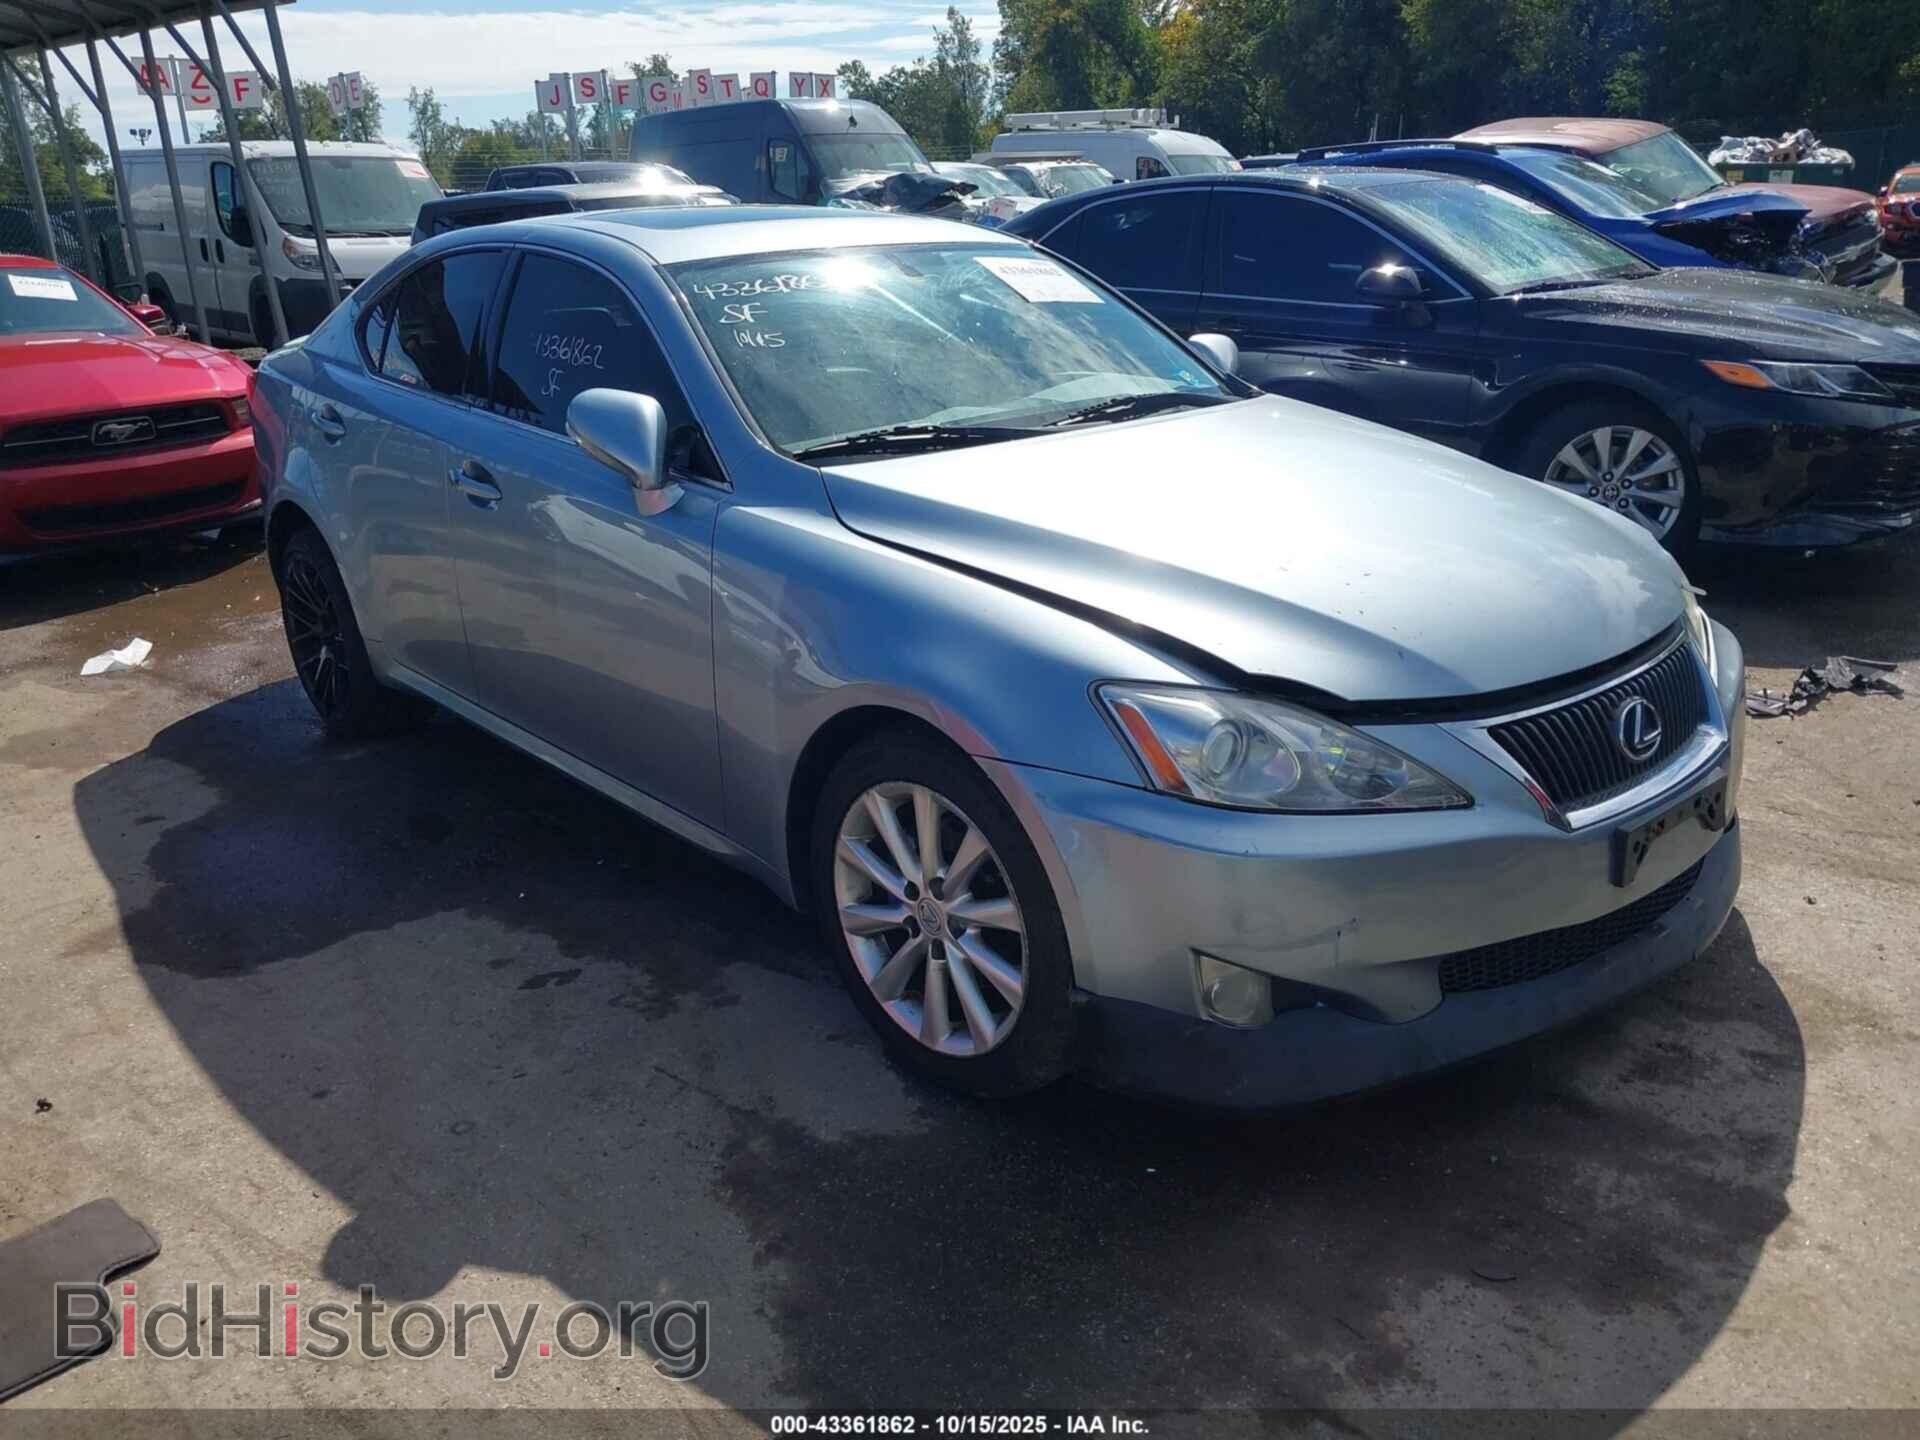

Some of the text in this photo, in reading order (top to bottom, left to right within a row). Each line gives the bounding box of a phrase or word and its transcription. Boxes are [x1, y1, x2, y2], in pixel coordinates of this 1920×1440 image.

[189, 64, 210, 90] Z
[580, 77, 596, 98] S
[697, 75, 708, 95] S
[793, 78, 806, 97] Y
[233, 78, 250, 102] F
[350, 79, 360, 101] E
[549, 84, 561, 106] J
[617, 84, 629, 105] F
[650, 82, 667, 102] G
[720, 79, 733, 98] T
[754, 78, 769, 98] Q
[819, 79, 830, 97] X
[719, 302, 768, 324] SF
